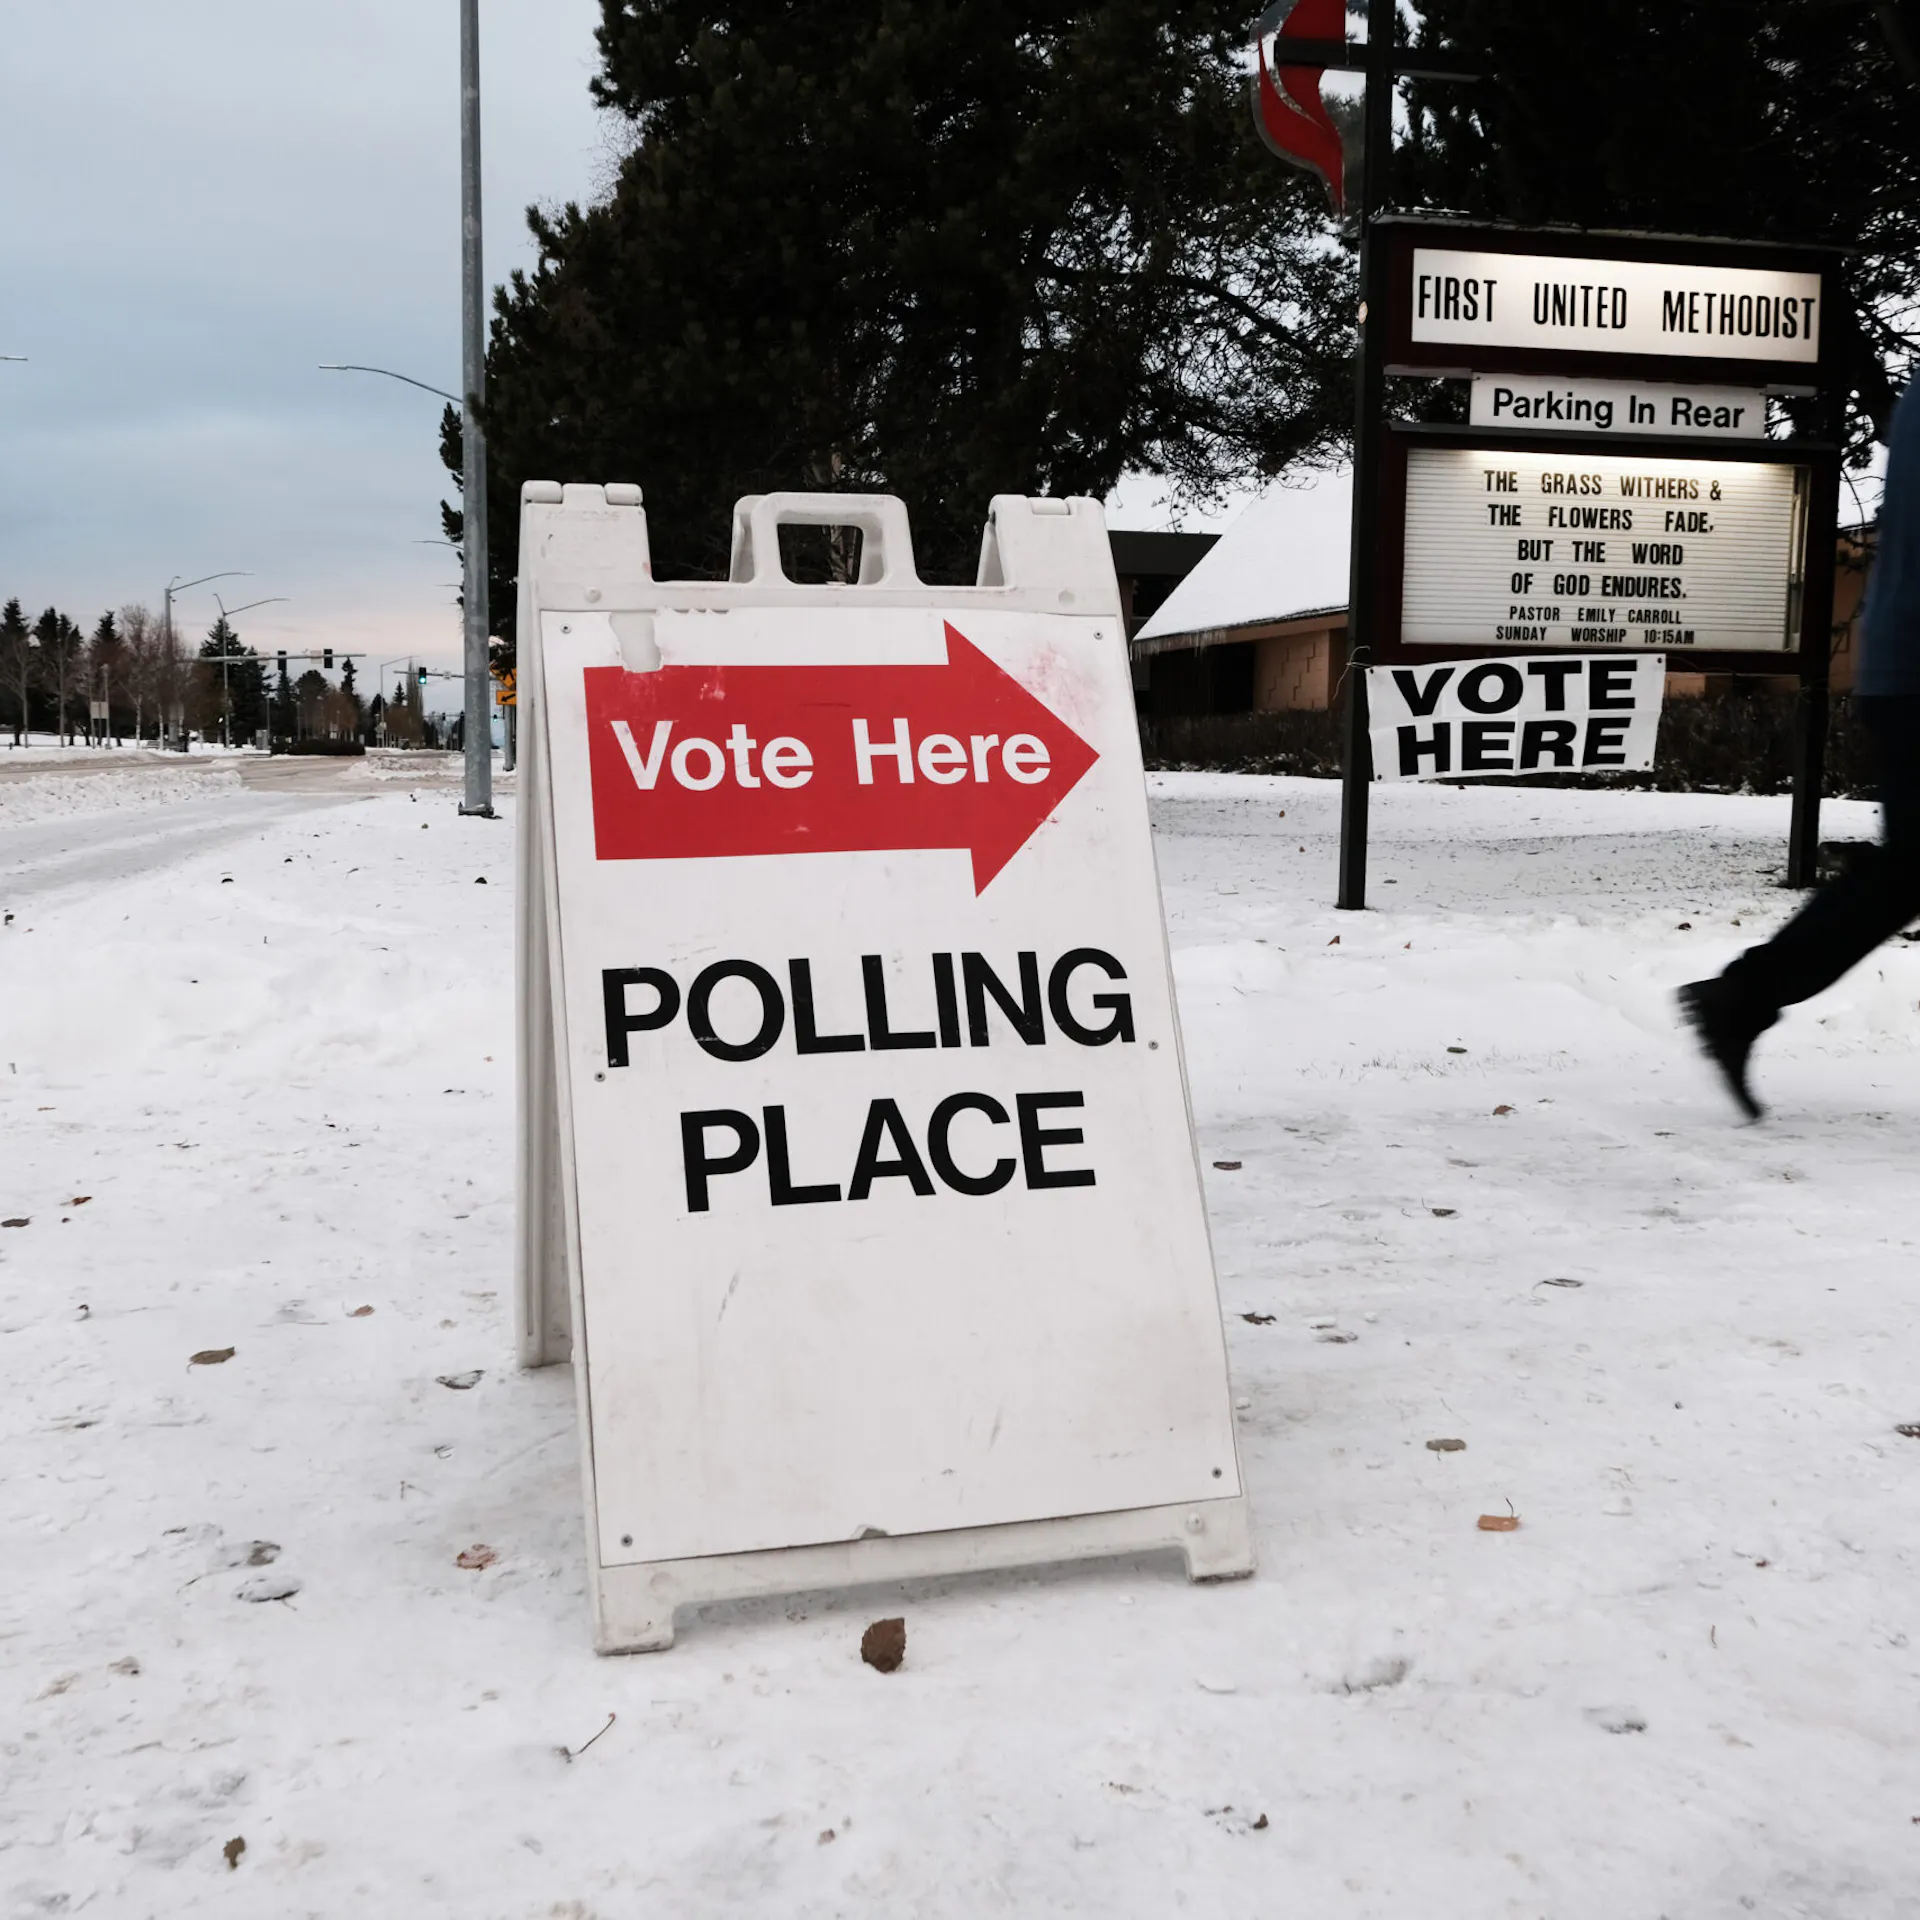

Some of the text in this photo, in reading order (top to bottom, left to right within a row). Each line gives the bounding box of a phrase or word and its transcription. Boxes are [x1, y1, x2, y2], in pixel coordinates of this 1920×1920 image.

[1418, 275, 1816, 340] FIRST UNITED METHODIST
[1493, 388, 1745, 429] Parking In Rear
[1484, 470, 1722, 501] THE GRASS WITHERS &
[1488, 504, 1521, 526] THE
[1548, 506, 1632, 530] FLOWERS
[1518, 539, 1683, 565] BUT THE WORD
[1511, 572, 1687, 599] OF GOD ENDURES.
[1496, 626, 1695, 644] SUNDAY WORSHIP 10:15AM
[1509, 606, 1682, 624] PASTOR EMILY CARROLL
[1391, 659, 1638, 717] VOTE
[610, 718, 1051, 791] Vote Here
[1396, 717, 1632, 777] HERE
[602, 947, 1136, 1069] POLLING
[680, 1090, 1097, 1214] PLACE
